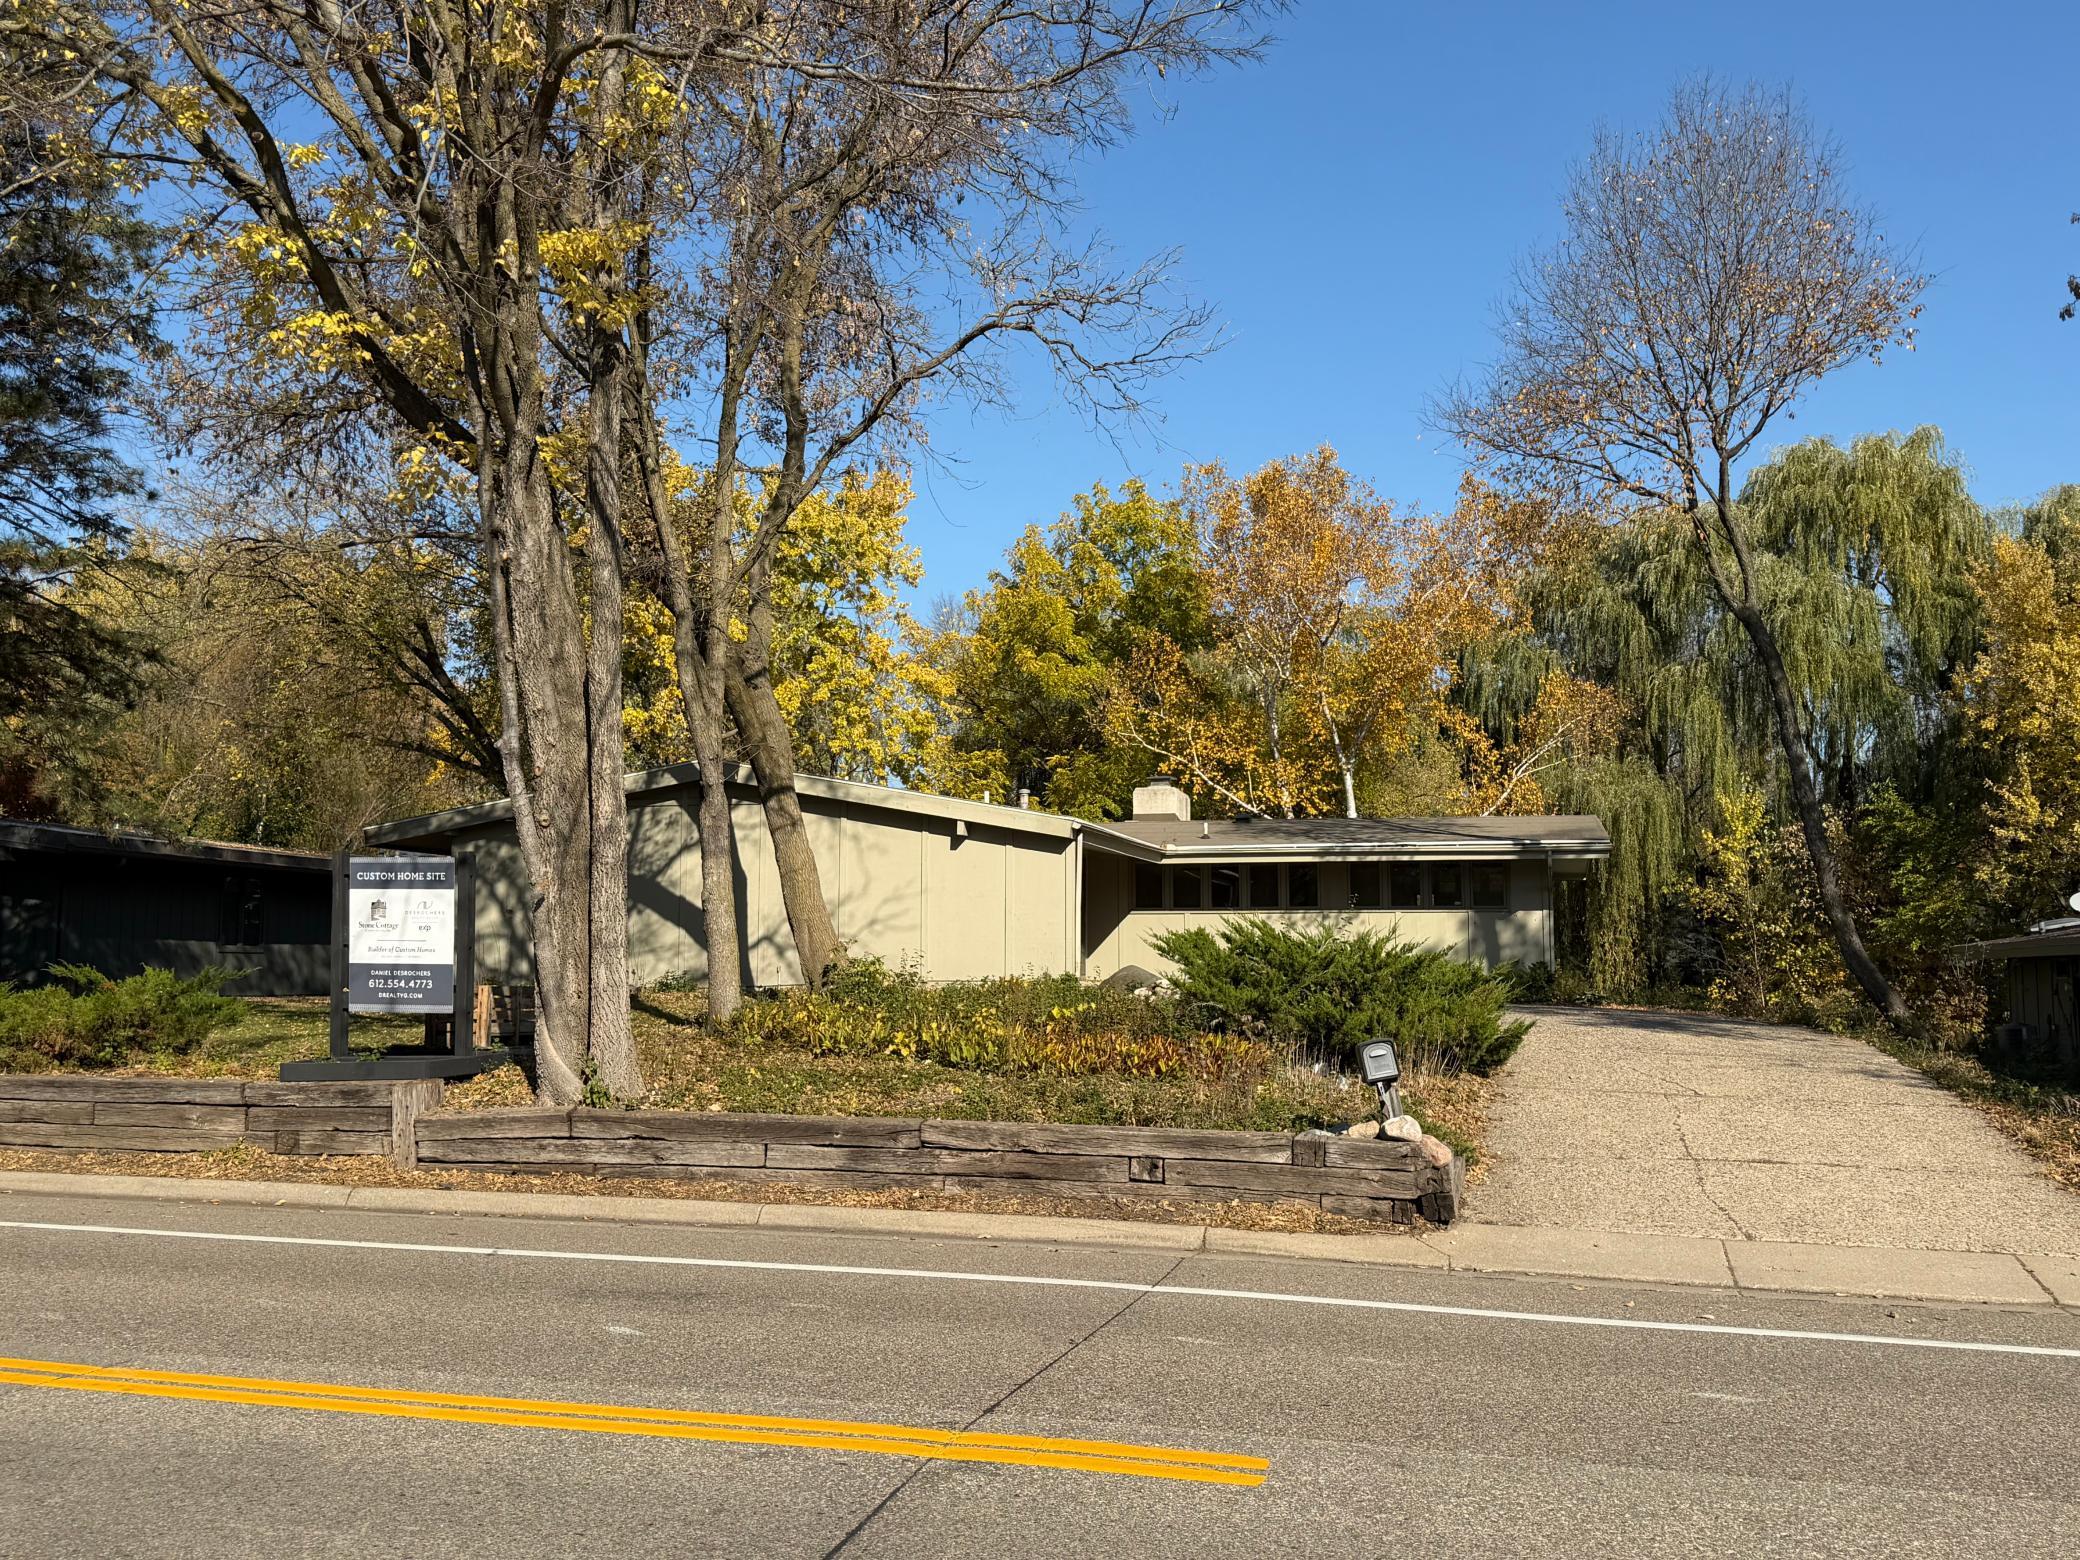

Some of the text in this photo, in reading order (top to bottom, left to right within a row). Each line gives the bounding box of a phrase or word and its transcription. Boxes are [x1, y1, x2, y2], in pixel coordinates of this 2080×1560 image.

[356, 871, 446, 881] CUSTOM HOME SITE
[358, 921, 399, 930] Stone Cottage
[388, 945, 395, 954] of
[368, 979, 433, 989] 612.554.4773
